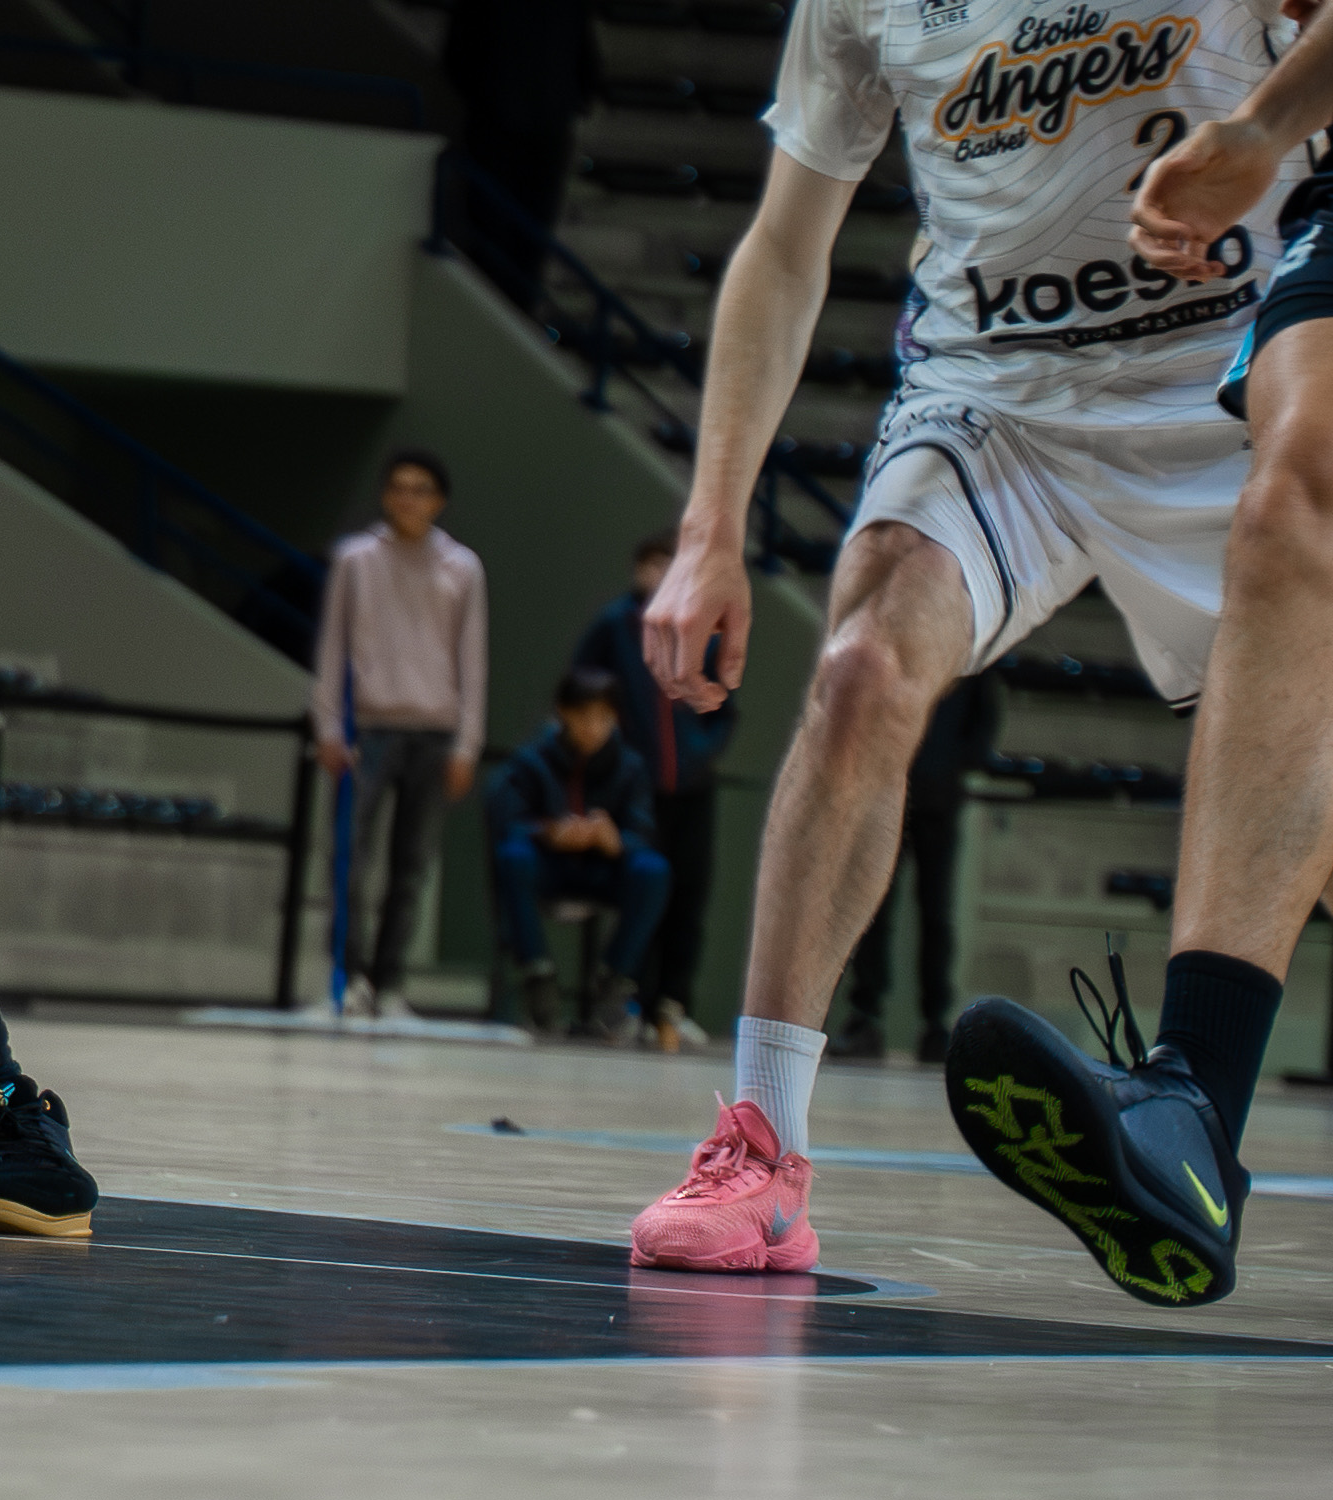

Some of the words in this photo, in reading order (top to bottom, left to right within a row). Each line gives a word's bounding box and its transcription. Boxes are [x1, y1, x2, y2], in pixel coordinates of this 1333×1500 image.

[1011, 3, 1110, 54] Etoile
[943, 24, 1194, 135] Angers
[953, 126, 1032, 163] Basket
[964, 224, 1252, 333] koeso
